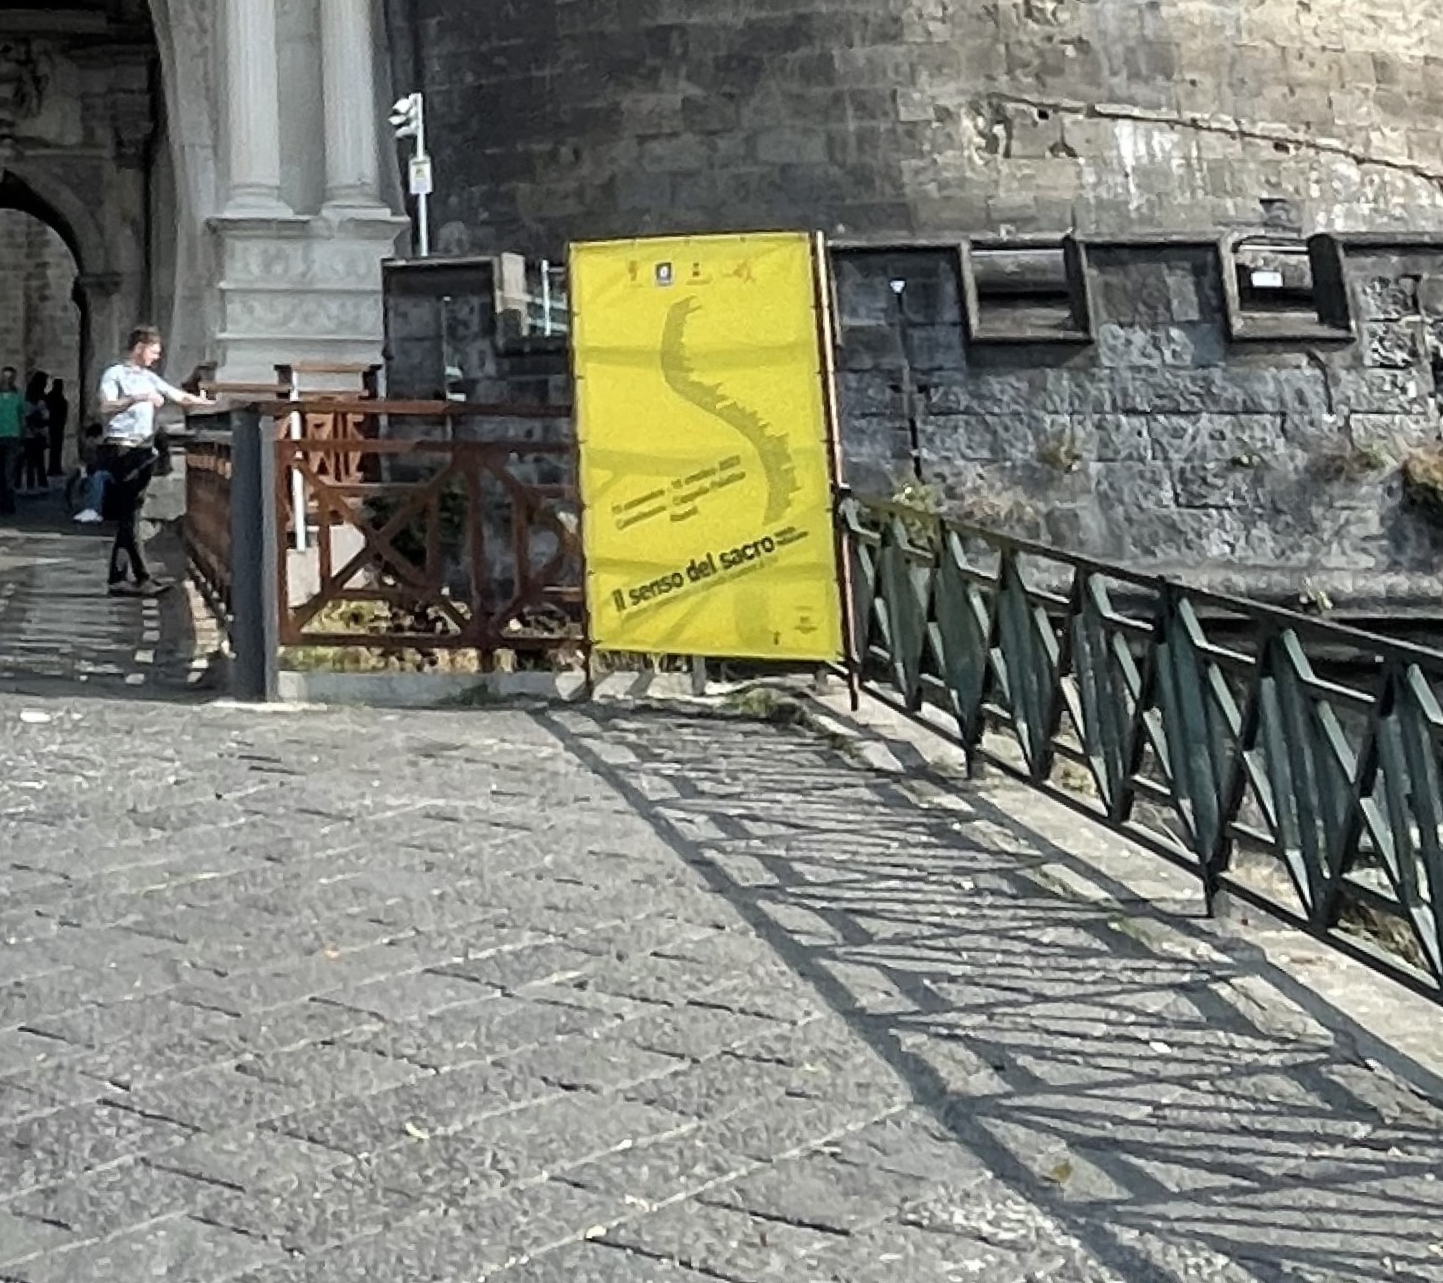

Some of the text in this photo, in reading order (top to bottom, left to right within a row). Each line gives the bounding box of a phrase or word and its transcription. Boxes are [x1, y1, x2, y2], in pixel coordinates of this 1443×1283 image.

[629, 573, 684, 606] senso
[686, 552, 717, 583] del
[719, 536, 774, 569] sacro
